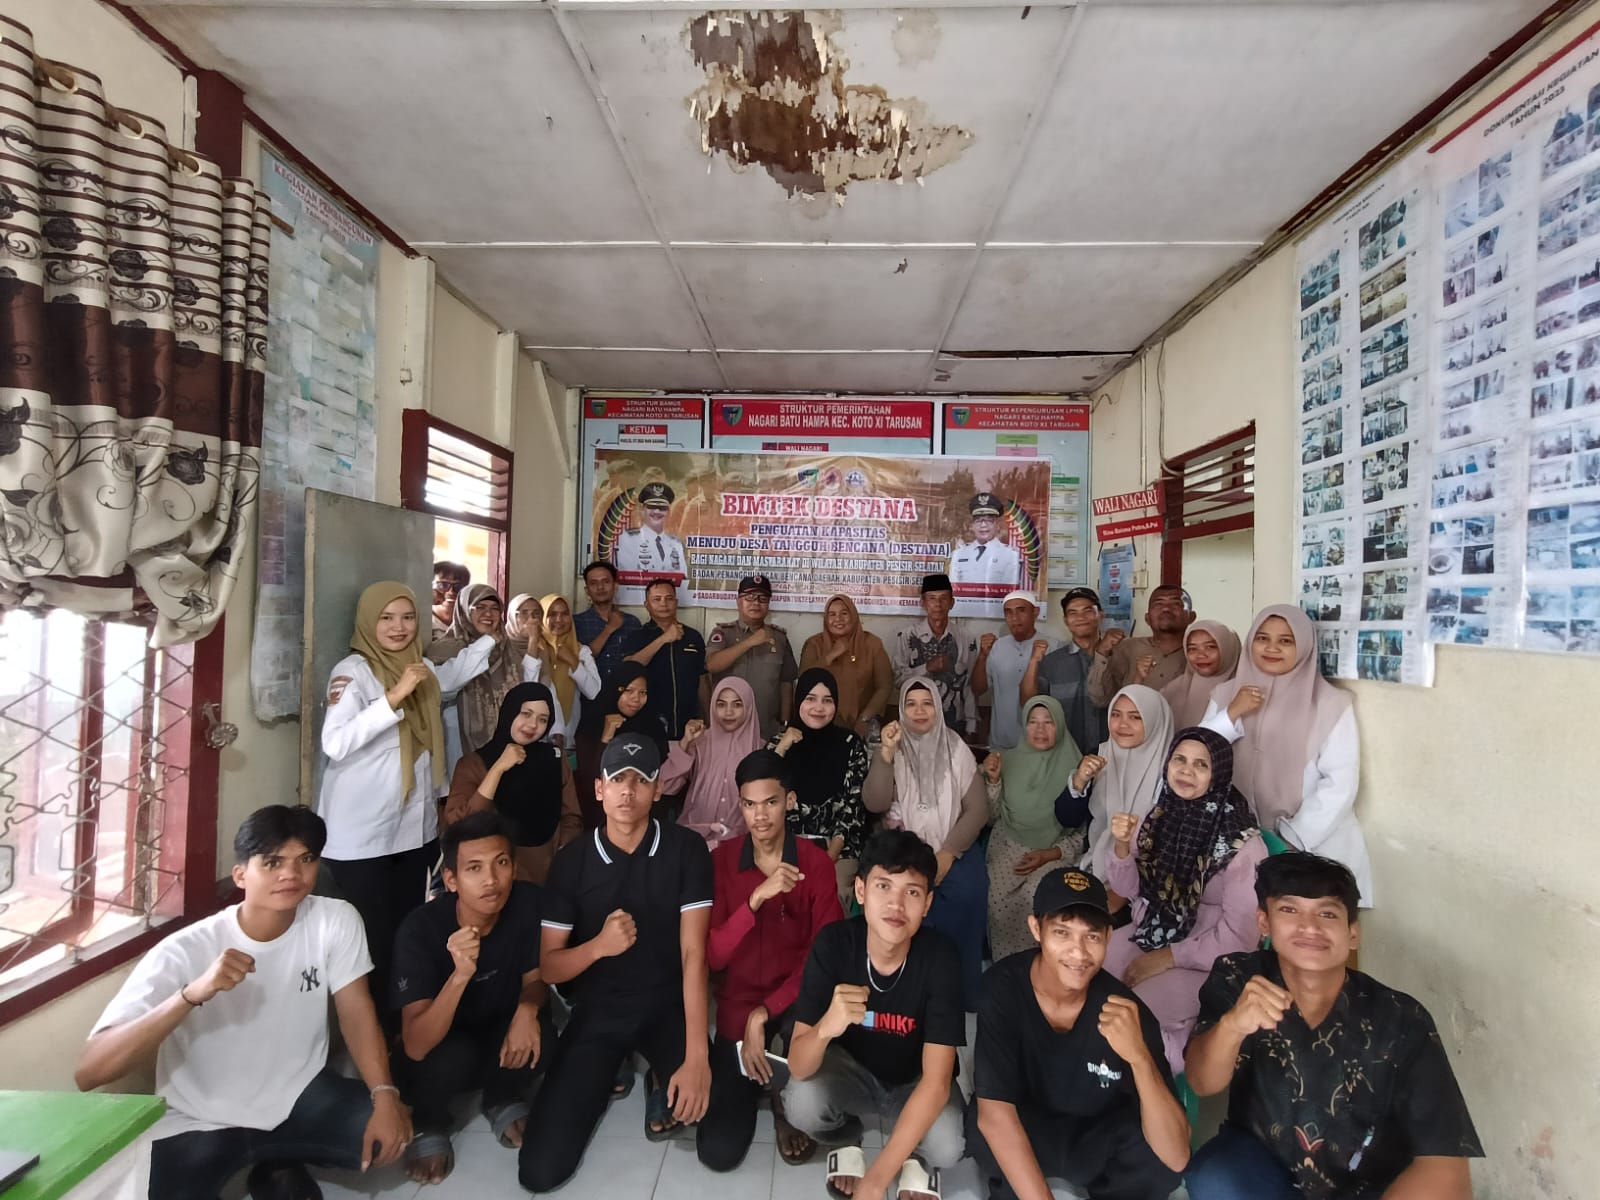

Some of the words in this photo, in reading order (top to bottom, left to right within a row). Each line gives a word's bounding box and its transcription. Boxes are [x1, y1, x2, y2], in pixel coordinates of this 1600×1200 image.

[1483, 90, 1545, 138] DOKUMENTASI
[1546, 47, 1600, 93] KEGIATAN
[1509, 103, 1541, 129] TAHUN
[779, 404, 824, 414] STRUKTUR
[826, 404, 891, 414] PEMERINTAHAN
[629, 425, 656, 434] KETUA
[748, 415, 778, 427] NAGARI
[780, 415, 801, 427] BATU
[802, 415, 830, 428] HAMPA
[831, 416, 850, 428] KEC.
[851, 416, 873, 428] KOTO
[875, 416, 884, 428] XI
[885, 416, 922, 429] TARUSAN
[722, 494, 810, 516] BIMTEK
[815, 497, 916, 520] DESTANA
[1094, 496, 1120, 514] WALI
[1120, 489, 1158, 510] NAGARI
[751, 524, 818, 536] PENGUATAN
[821, 526, 886, 538] KAPASITAS
[687, 536, 736, 548] MENUJU
[740, 538, 769, 550] DESA
[773, 539, 828, 551] TANGGUH
[831, 541, 886, 553] BENCANA
[889, 542, 950, 557] (DESTANA)
[691, 553, 707, 565] BAGI
[708, 554, 736, 566] NAGARI
[736, 555, 752, 566] DAN
[752, 555, 800, 567] MASYARAKAT
[811, 558, 843, 569] WILAYAH
[844, 559, 885, 570] KABUPATEN
[886, 560, 913, 571] PESISIR
[914, 561, 945, 573] SELATAN
[692, 569, 715, 579] BADAN
[780, 571, 811, 582] BENCANA
[813, 573, 840, 583] DAERAH
[842, 574, 881, 584] KABUPATEN
[882, 575, 909, 585] PESISIR
[300, 966, 320, 992] NY
